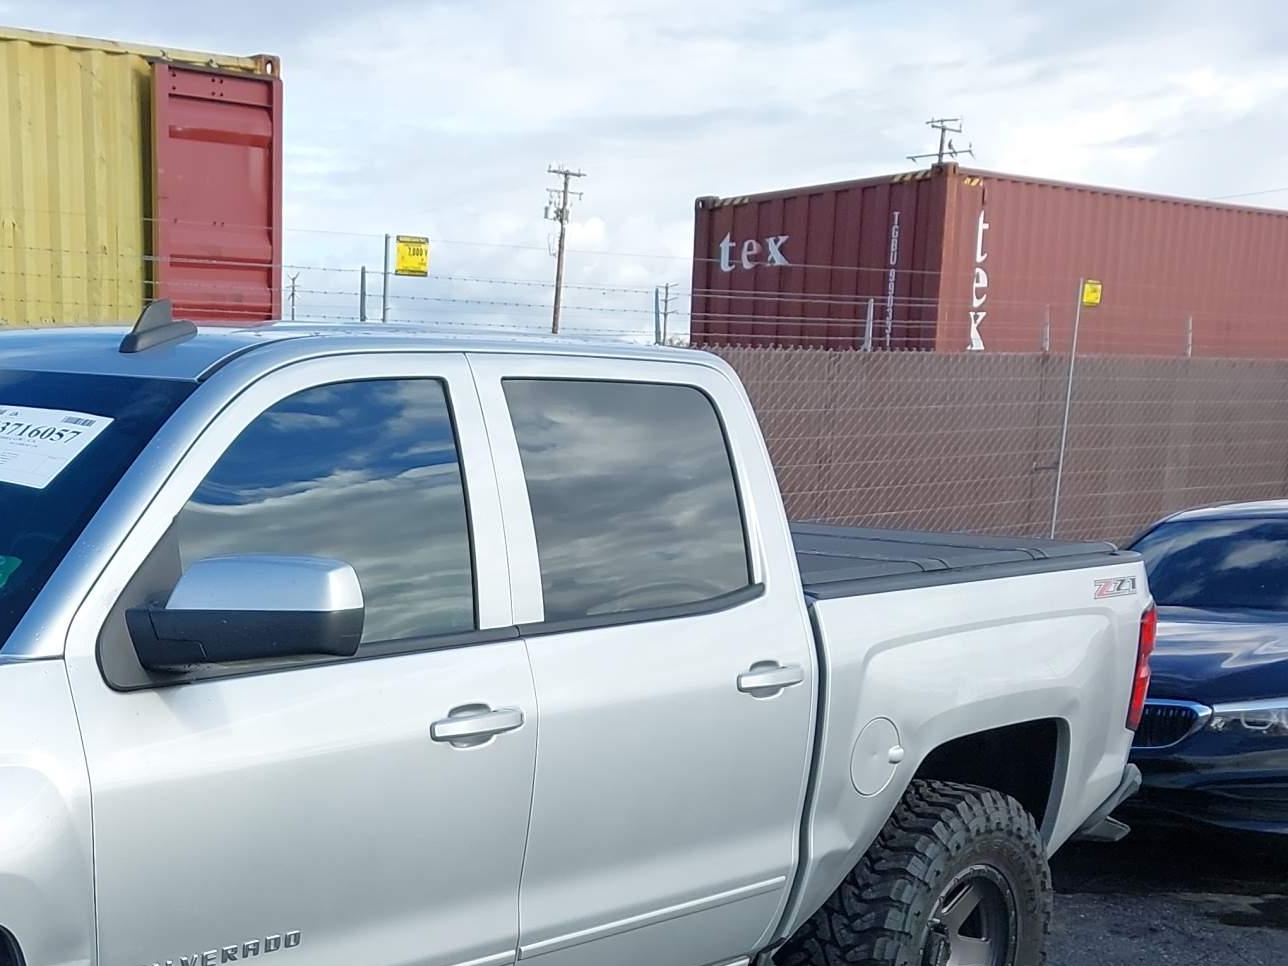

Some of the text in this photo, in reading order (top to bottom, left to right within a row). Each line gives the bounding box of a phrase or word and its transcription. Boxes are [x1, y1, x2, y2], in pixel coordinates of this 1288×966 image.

[718, 232, 791, 272] tex
[966, 209, 989, 351] tex
[1094, 576, 1137, 599] Z71
